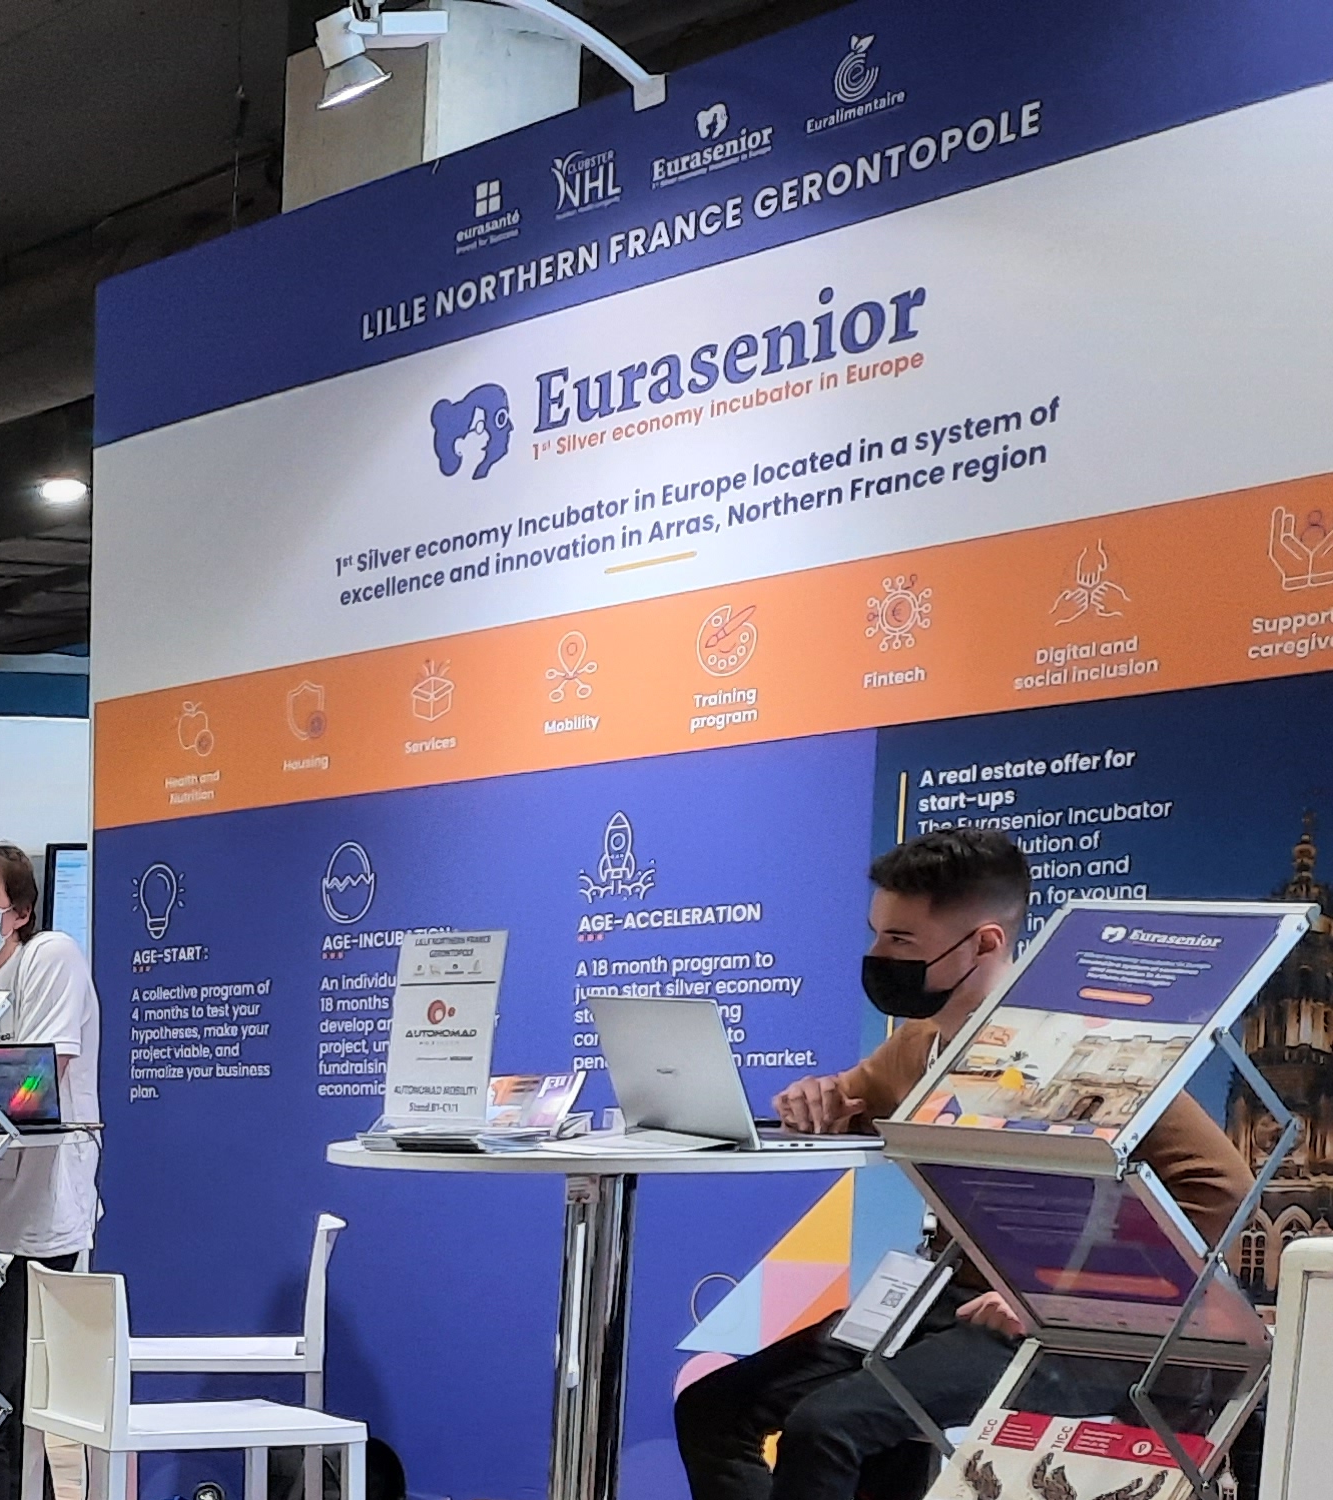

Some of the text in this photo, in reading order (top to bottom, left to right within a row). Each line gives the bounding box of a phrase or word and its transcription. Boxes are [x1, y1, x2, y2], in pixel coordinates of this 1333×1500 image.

[807, 91, 905, 133] Euralimentaire
[653, 126, 772, 182] Eurasenior
[552, 160, 621, 211] NHL
[362, 297, 426, 340] LILLE
[435, 242, 598, 317] NORTHERN
[609, 197, 742, 263] FRANCE
[754, 101, 1041, 218] GERONTOPOLE
[456, 209, 520, 242] eurasanté
[534, 286, 926, 433] Eurasenior
[557, 428, 606, 456] Silver
[612, 406, 703, 441] economy
[710, 379, 813, 417] incubator
[820, 372, 838, 389] in
[847, 352, 924, 384] Europe
[335, 396, 1060, 577] 1st Silver economy Incubator in Europe located in a system of
[340, 444, 1047, 605] excellence and innovation in Arras, Northern France region
[1036, 636, 1138, 667] Digital and
[863, 667, 925, 689] Fintech
[1013, 658, 1158, 690] social inclusion
[693, 687, 757, 709] Training
[544, 714, 600, 735] Mobility
[689, 708, 757, 734] program
[405, 736, 456, 754] Services
[283, 755, 329, 771] Housing
[919, 749, 1135, 787] A real estate offer for
[199, 770, 220, 784] and
[918, 788, 1015, 812] start-ups
[1068, 800, 1173, 826] Incubator
[1080, 831, 1101, 850] of
[1087, 855, 1130, 876] and
[1048, 888, 1075, 905] for
[578, 903, 761, 932] AGE-ACCELERATION
[1129, 928, 1222, 948] Eurasenior
[576, 952, 773, 977] A 18 month program to
[132, 979, 271, 1001] A collective program of
[321, 977, 339, 991] An
[666, 979, 711, 996] silver
[716, 977, 802, 996] economy
[132, 1004, 260, 1021] 4 months to test your
[321, 995, 389, 1011] 18 months
[131, 1023, 269, 1044] hypotheses, make your
[320, 1019, 373, 1035] develop
[131, 1043, 239, 1064] project viable, and
[319, 1040, 369, 1058] project,
[747, 1050, 817, 1067] market.
[131, 1063, 270, 1082] formalize your business
[319, 1059, 387, 1075] fundraisin
[130, 1084, 159, 1103] plan.
